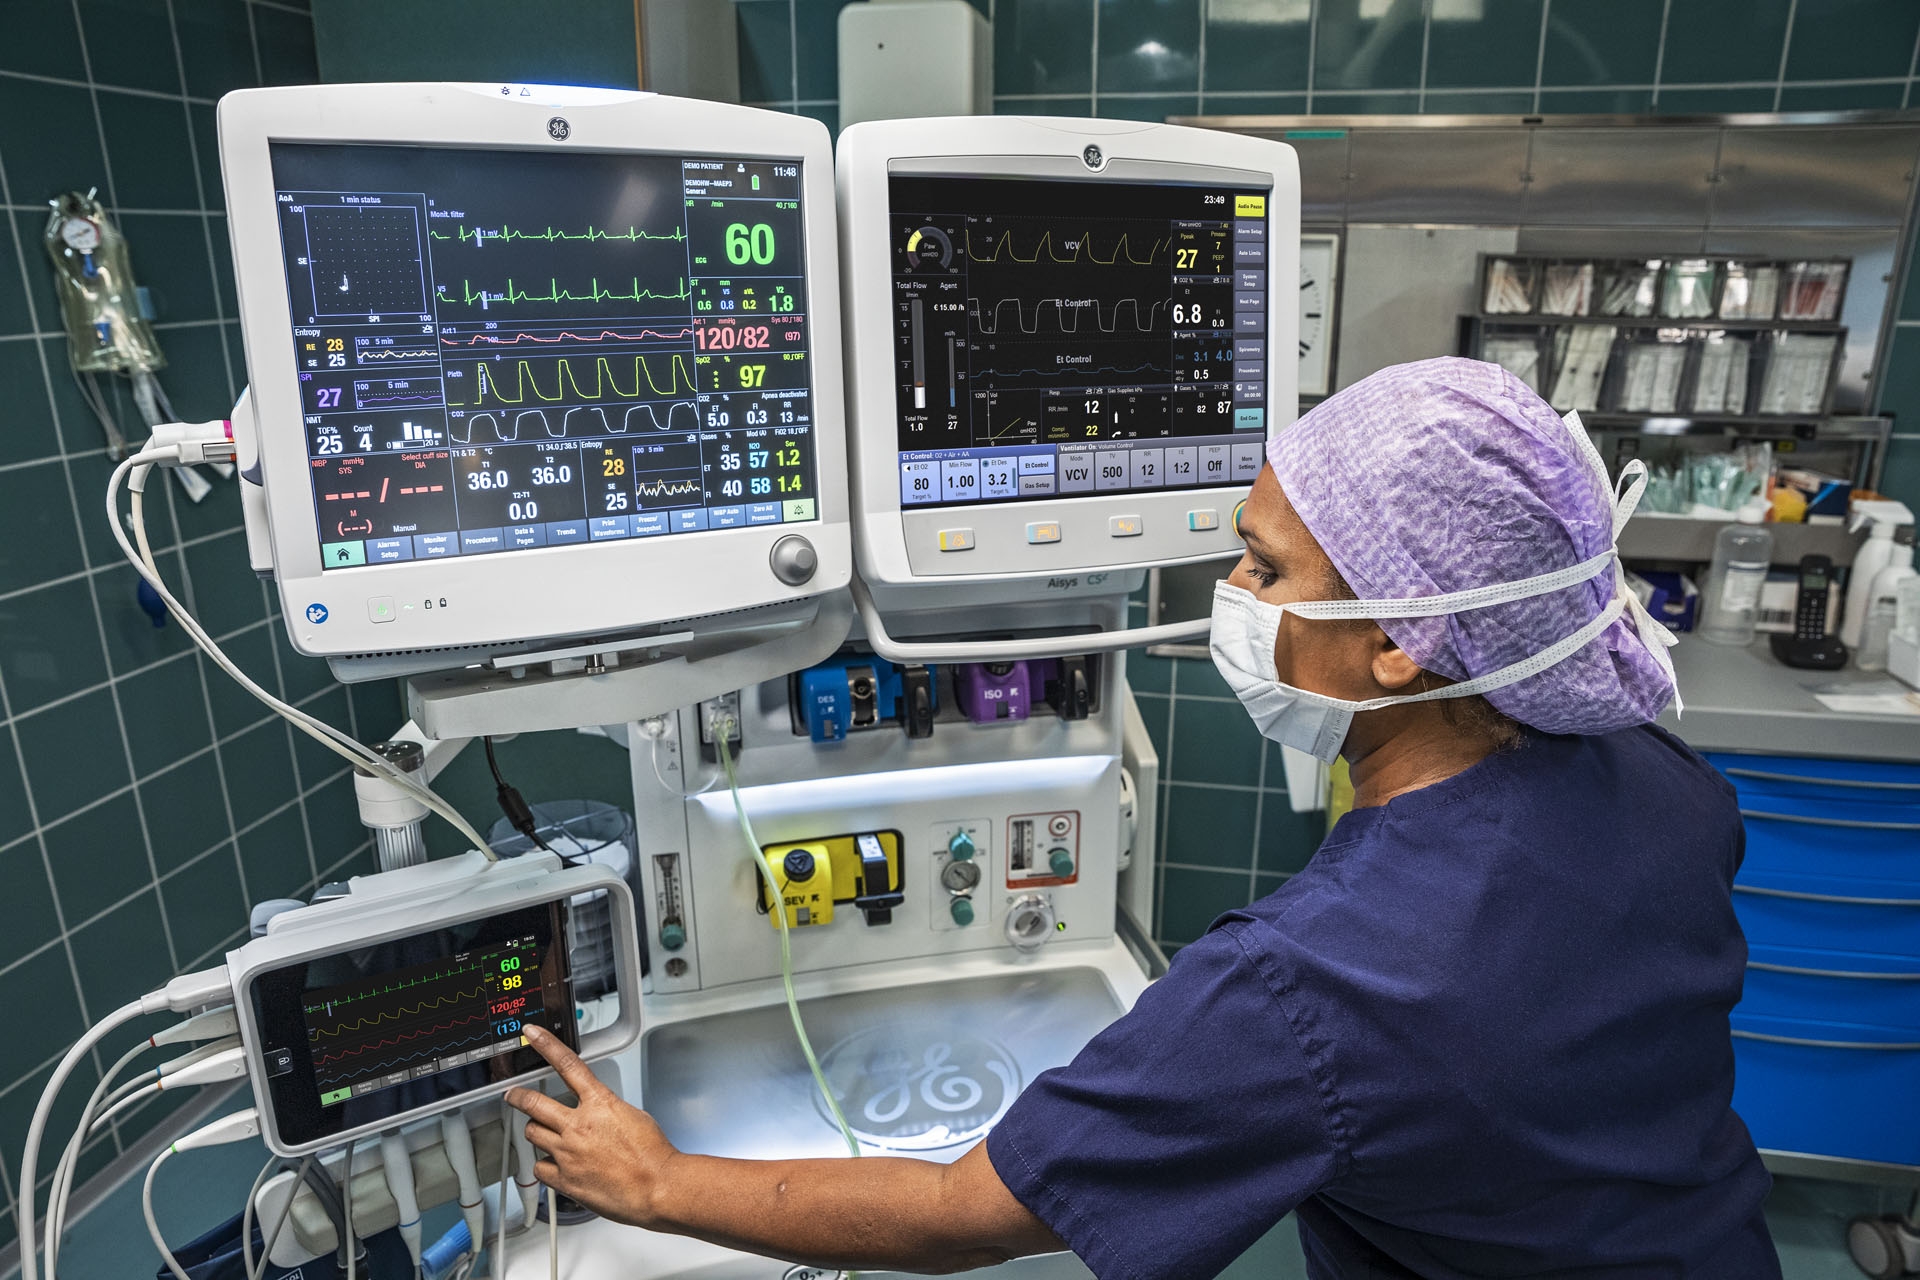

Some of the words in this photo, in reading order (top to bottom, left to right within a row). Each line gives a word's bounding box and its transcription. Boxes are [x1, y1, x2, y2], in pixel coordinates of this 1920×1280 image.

[684, 162, 700, 170] DEMO
[774, 166, 796, 176] 11:48
[1204, 195, 1225, 204] 23:49
[725, 222, 775, 266] 60
[1065, 241, 1080, 250] VCV
[1216, 242, 1221, 250] 7
[1176, 249, 1198, 268] 27
[698, 300, 712, 310] 0.6
[720, 300, 734, 310] 0.8
[742, 299, 756, 310] 0.2
[769, 295, 794, 312] 1.8
[1064, 299, 1091, 307] Control
[1173, 304, 1202, 324] 6.8
[1212, 319, 1225, 327] 0.0
[295, 328, 320, 337] Entropy
[695, 326, 770, 350] 120/82
[785, 331, 800, 341] (97)
[326, 339, 344, 351] 28
[328, 354, 345, 366] 25
[696, 356, 711, 364] SpO2
[1066, 355, 1092, 363] Control
[1194, 352, 1208, 362] 3.1
[1216, 350, 1233, 361] 4.0
[739, 365, 766, 388] 97
[1194, 370, 1209, 379] 0.5
[317, 388, 342, 408] 27
[1085, 400, 1099, 414] 12
[1197, 405, 1206, 413] 82
[1217, 401, 1231, 414] 87
[708, 412, 729, 427] 5.0
[747, 410, 767, 424] 0.3
[780, 412, 793, 423] 13
[910, 423, 923, 431] 1.0
[948, 421, 958, 430] 27
[1086, 425, 1098, 436] 22
[317, 434, 342, 454] 25
[359, 433, 372, 451] 4
[1060, 444, 1087, 452] Ventilator
[343, 458, 364, 466] mmHg
[401, 453, 421, 461] Select
[720, 453, 740, 470] 35
[749, 451, 769, 468] 57
[776, 449, 800, 466] 1.2
[602, 458, 625, 477] 28
[1102, 466, 1123, 478] 500
[1142, 464, 1154, 476] 12
[1174, 462, 1190, 473] 1:2
[1207, 460, 1222, 472] Off
[468, 470, 509, 490] 36.0
[531, 465, 571, 485] 36.0
[988, 473, 1007, 486] 3.2
[1065, 468, 1088, 481] VCV
[722, 480, 742, 496] 40
[751, 478, 770, 494] 58
[778, 475, 802, 492] 1.4
[914, 478, 929, 490] 80
[948, 475, 974, 489] 1.00
[606, 492, 628, 511] 25
[509, 501, 537, 520] 0.0
[393, 524, 417, 533] Manual
[377, 541, 400, 549] Alarms
[424, 536, 447, 544] Monitor
[465, 536, 498, 545] Procedures
[1048, 578, 1078, 590] Aisys
[817, 695, 835, 703] DES
[984, 690, 1003, 699] ISO
[784, 896, 805, 905] SEV
[500, 956, 520, 972] 60
[502, 975, 522, 991] 98
[490, 997, 526, 1015] 120/82
[497, 1020, 521, 1036] (13)
